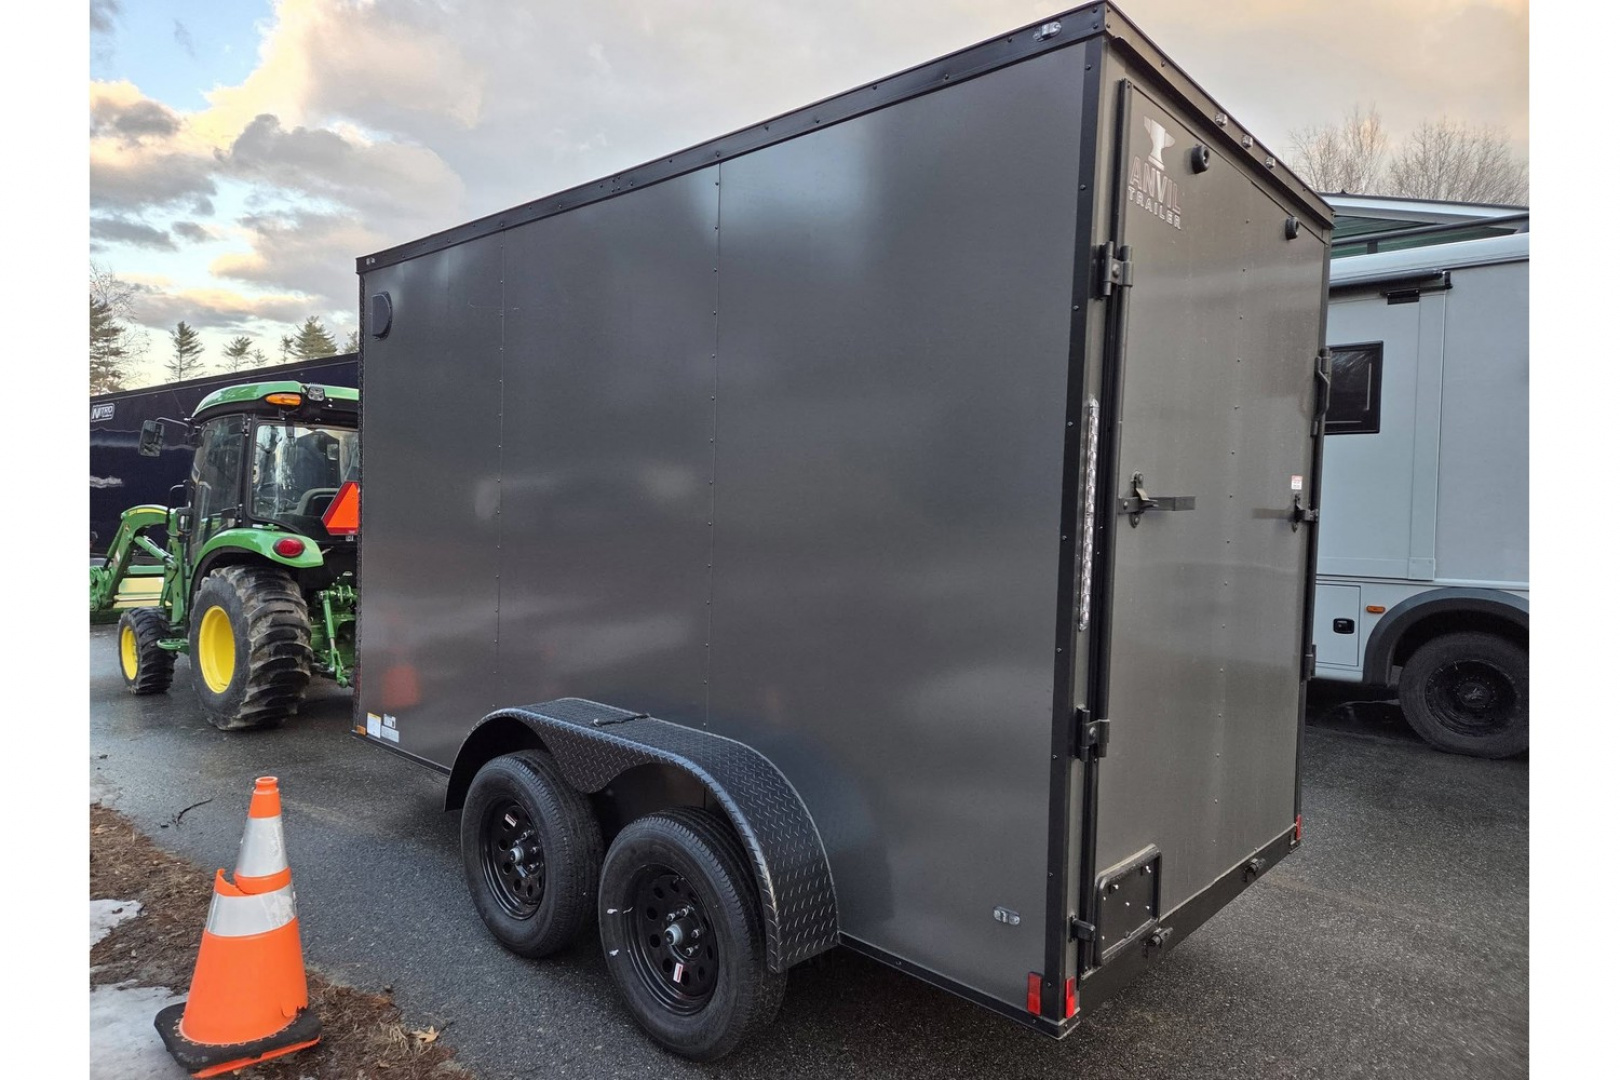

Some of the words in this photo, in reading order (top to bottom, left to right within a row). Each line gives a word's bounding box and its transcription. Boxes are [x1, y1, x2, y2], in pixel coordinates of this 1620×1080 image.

[1128, 185, 1181, 230] TRAILER
[1129, 156, 1181, 215] ANVIL
[91, 405, 113, 419] NITRO
